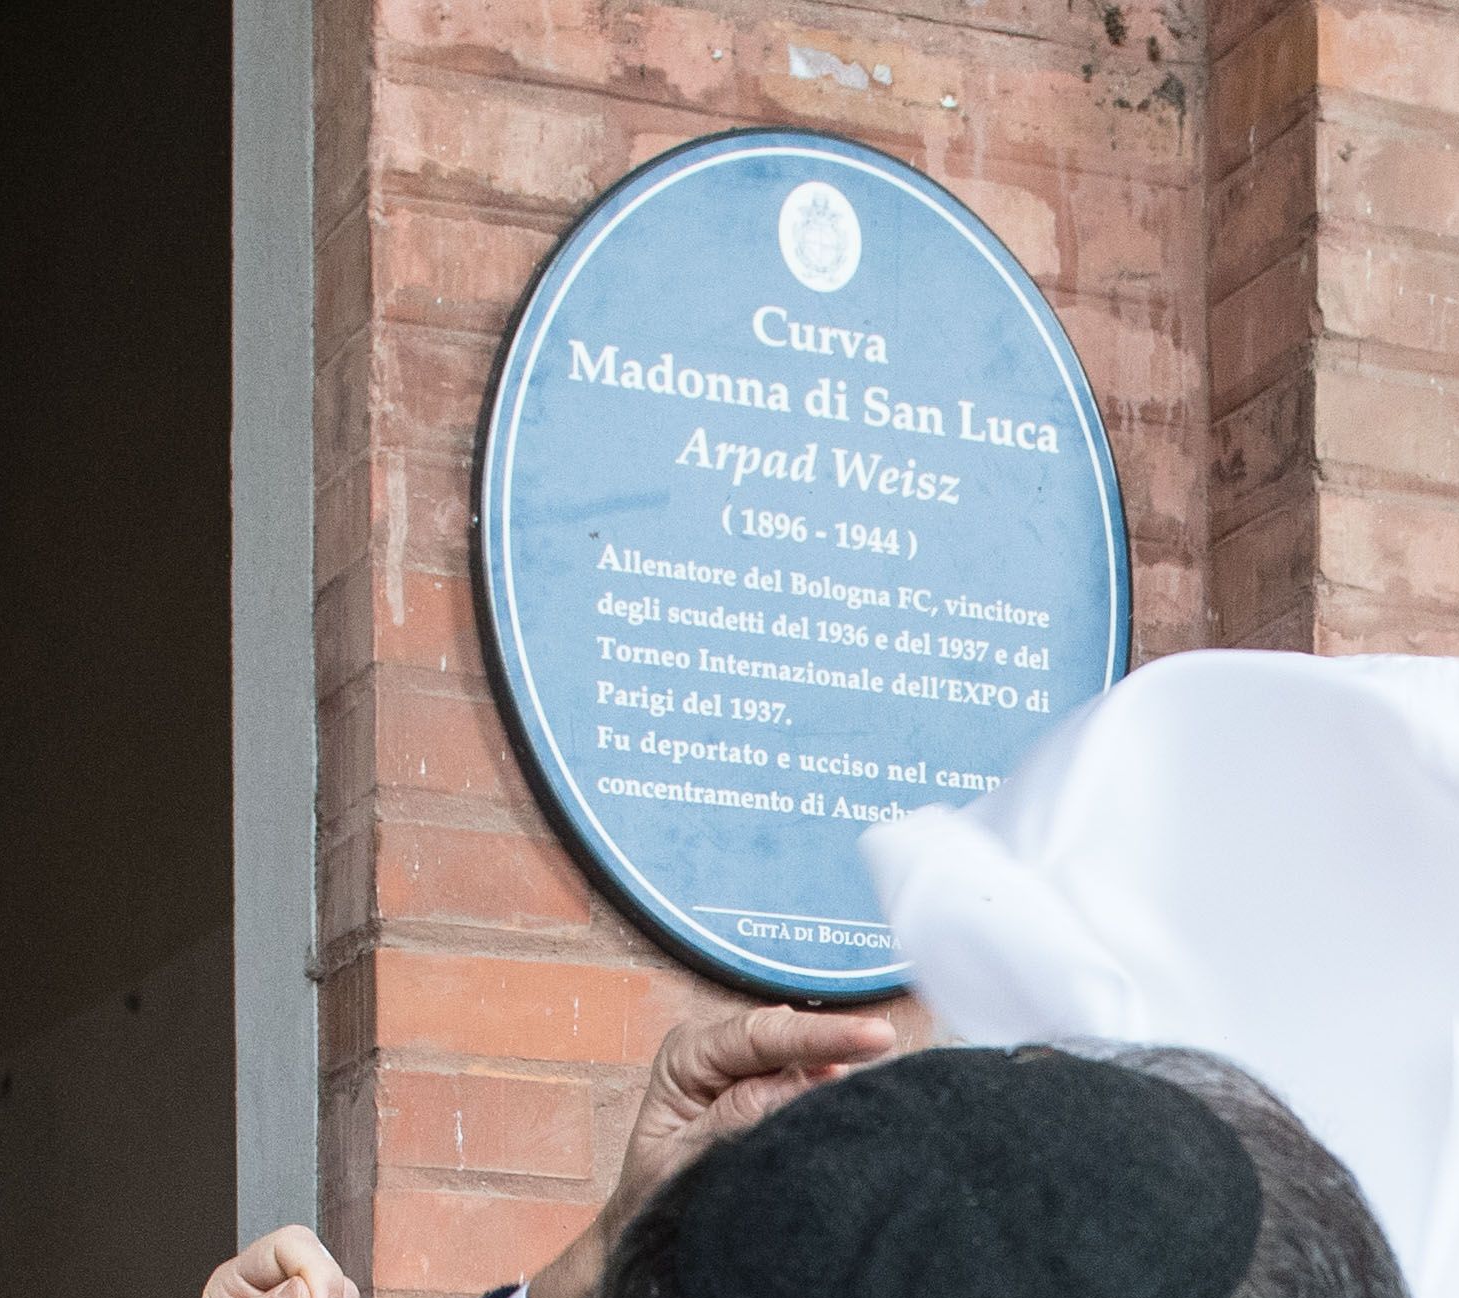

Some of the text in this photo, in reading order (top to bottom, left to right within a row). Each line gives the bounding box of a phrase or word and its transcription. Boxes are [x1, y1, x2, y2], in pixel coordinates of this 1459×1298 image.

[752, 305, 889, 364] Curva
[568, 339, 1060, 454] Madonna di San Luca
[675, 426, 961, 505] Arpad Weisz
[596, 543, 1050, 629] Allenatore del Bologna FC, vincitore
[597, 592, 1050, 671] degli scudetti del 1936 e del 1937 e del
[596, 636, 1051, 714] Torneo Internazionale dell'EXPO di
[596, 680, 793, 726] Parigi del 1937.
[597, 725, 1007, 794] Fu deportato e ucciso nel camp
[597, 775, 913, 824] concentramento di Ausch
